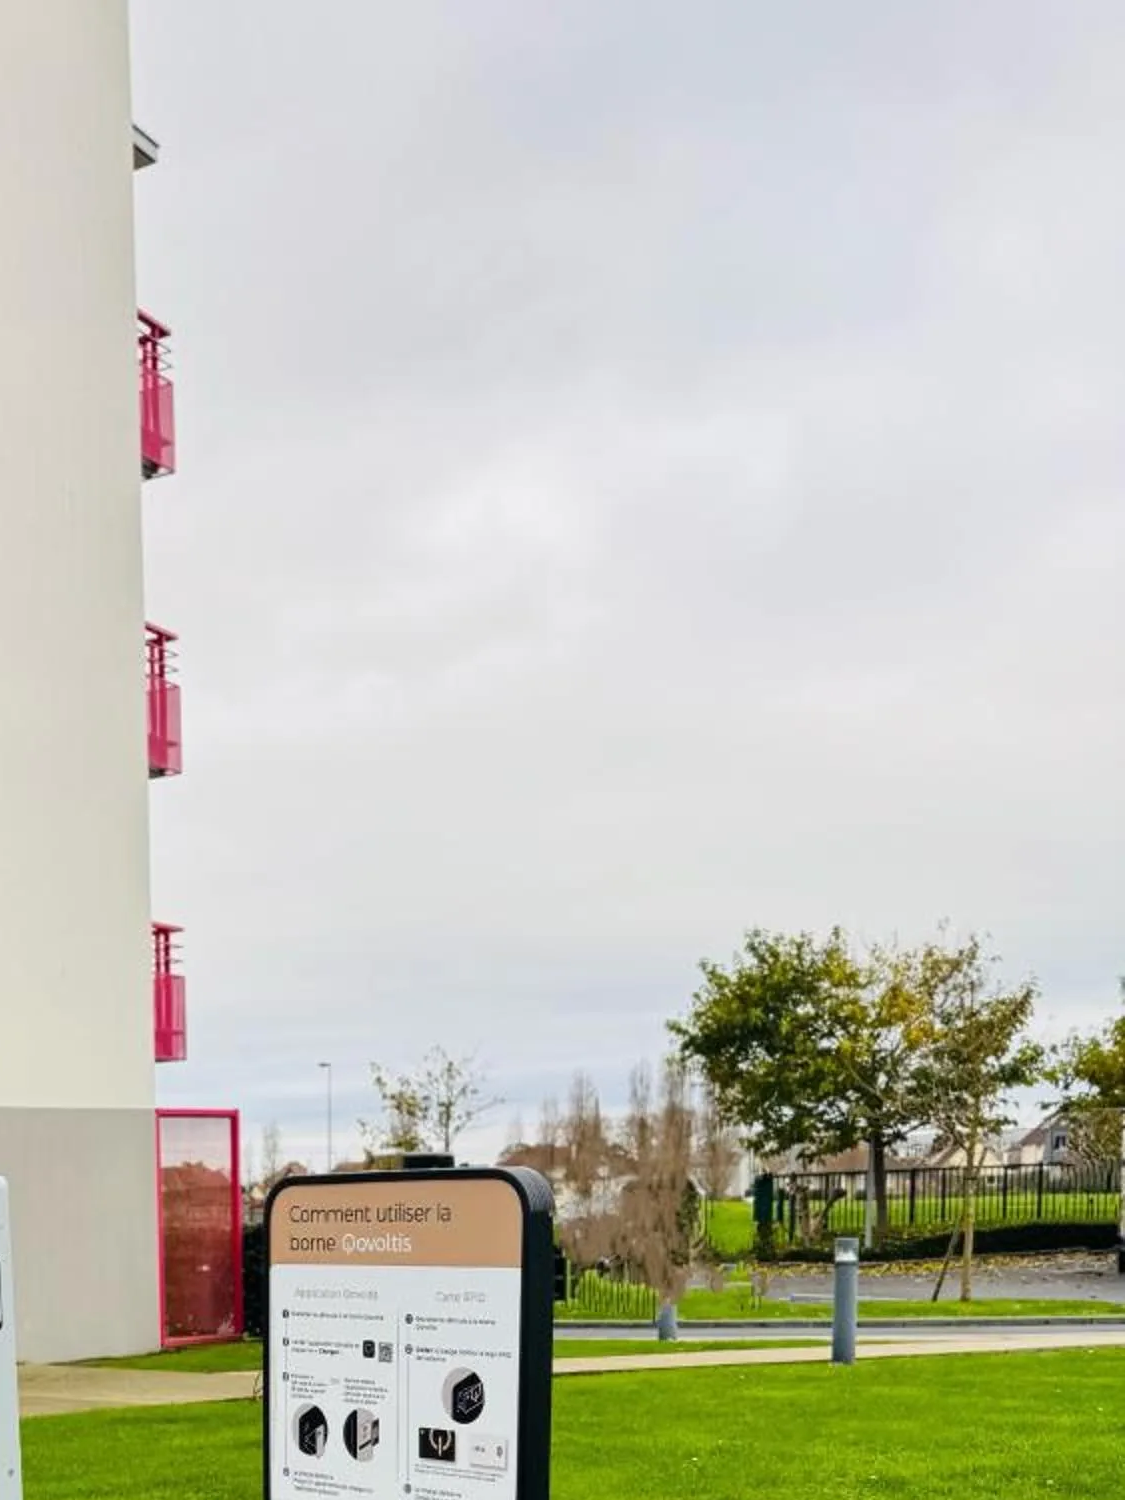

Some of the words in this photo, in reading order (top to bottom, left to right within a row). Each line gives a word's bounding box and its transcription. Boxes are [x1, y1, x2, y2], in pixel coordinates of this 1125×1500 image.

[289, 1204, 372, 1223] Comment
[376, 1203, 431, 1223] utiliser
[436, 1203, 452, 1223] la
[341, 1233, 412, 1255] Qovoltis
